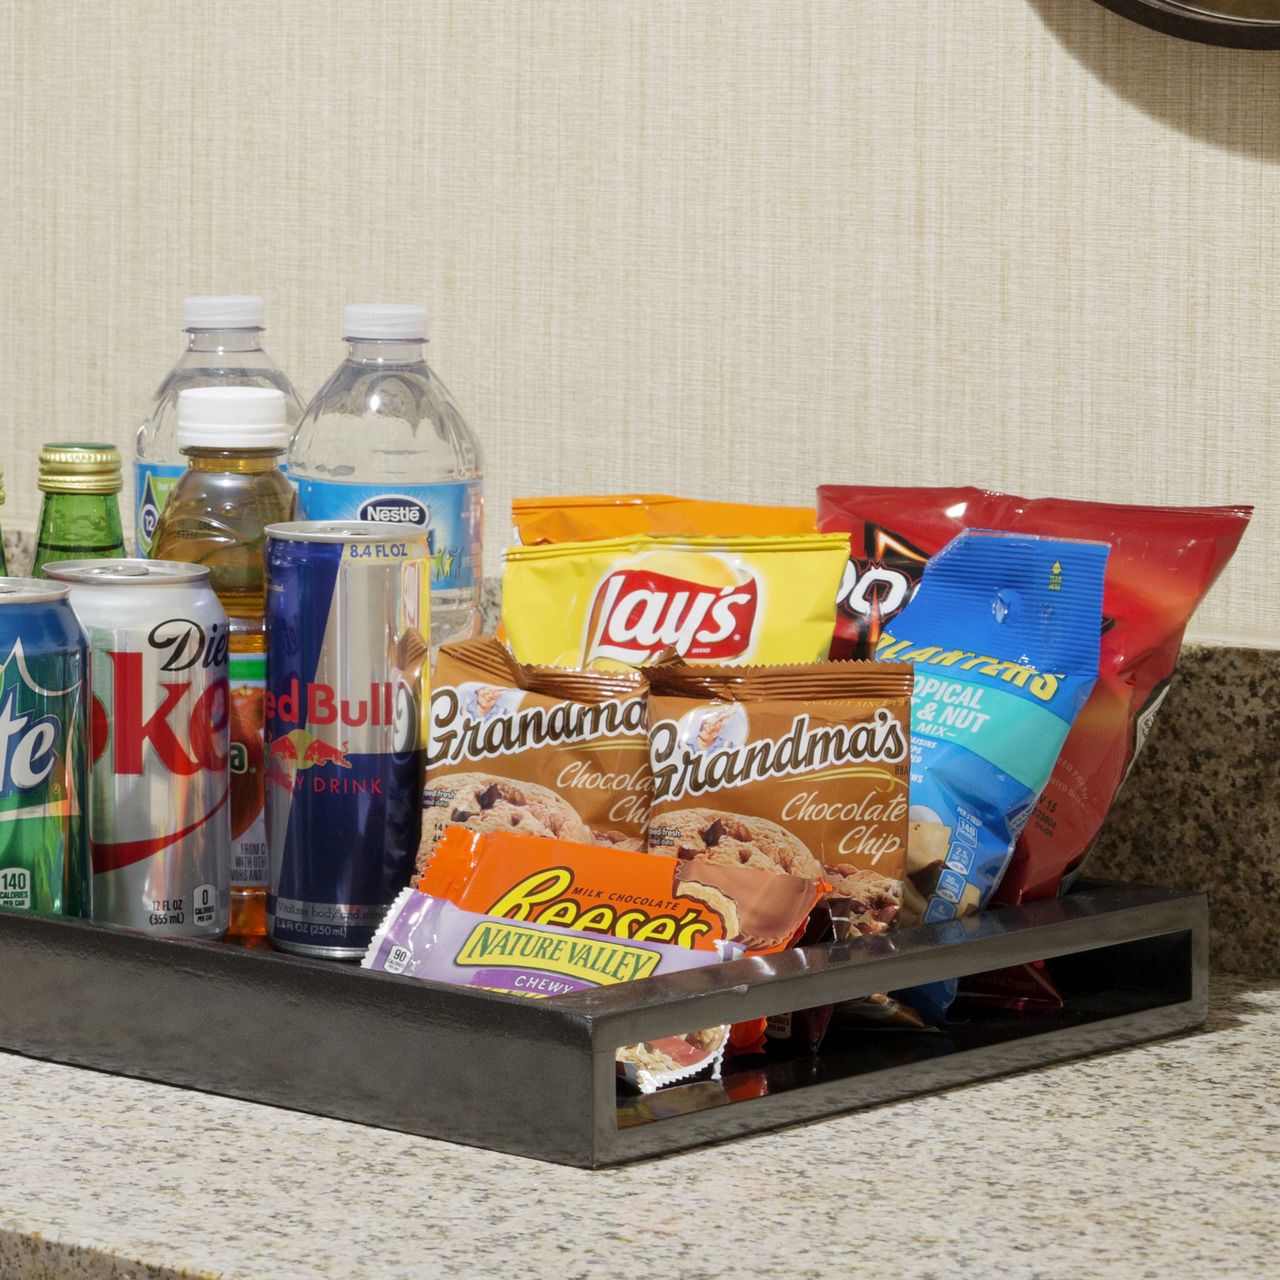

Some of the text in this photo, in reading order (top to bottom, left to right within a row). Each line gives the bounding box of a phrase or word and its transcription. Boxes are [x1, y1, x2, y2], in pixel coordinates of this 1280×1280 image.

[350, 543, 408, 558] 8.4 FL OZ
[589, 575, 752, 665] Lay's
[876, 632, 1067, 702] PLANTERS
[307, 682, 393, 728] Bull
[916, 702, 938, 721] &
[938, 706, 992, 734] NUT
[650, 711, 905, 802] Grandma's
[313, 777, 382, 795] DRINK
[781, 791, 908, 822] Chocolate
[241, 843, 259, 856] FROM
[838, 824, 901, 866] Chip
[1, 872, 26, 890] 140
[0, 891, 28, 899] CALORIES
[202, 889, 209, 906] 0
[571, 886, 681, 911] MILK CHOCOLATE
[152, 899, 183, 912] 12 FL OZ
[311, 905, 337, 921] body
[149, 913, 168, 926] (355
[310, 924, 332, 937] (250
[393, 948, 407, 962] 90
[466, 926, 654, 982] NATURE VALLEY
[514, 975, 575, 995] CHEWY
